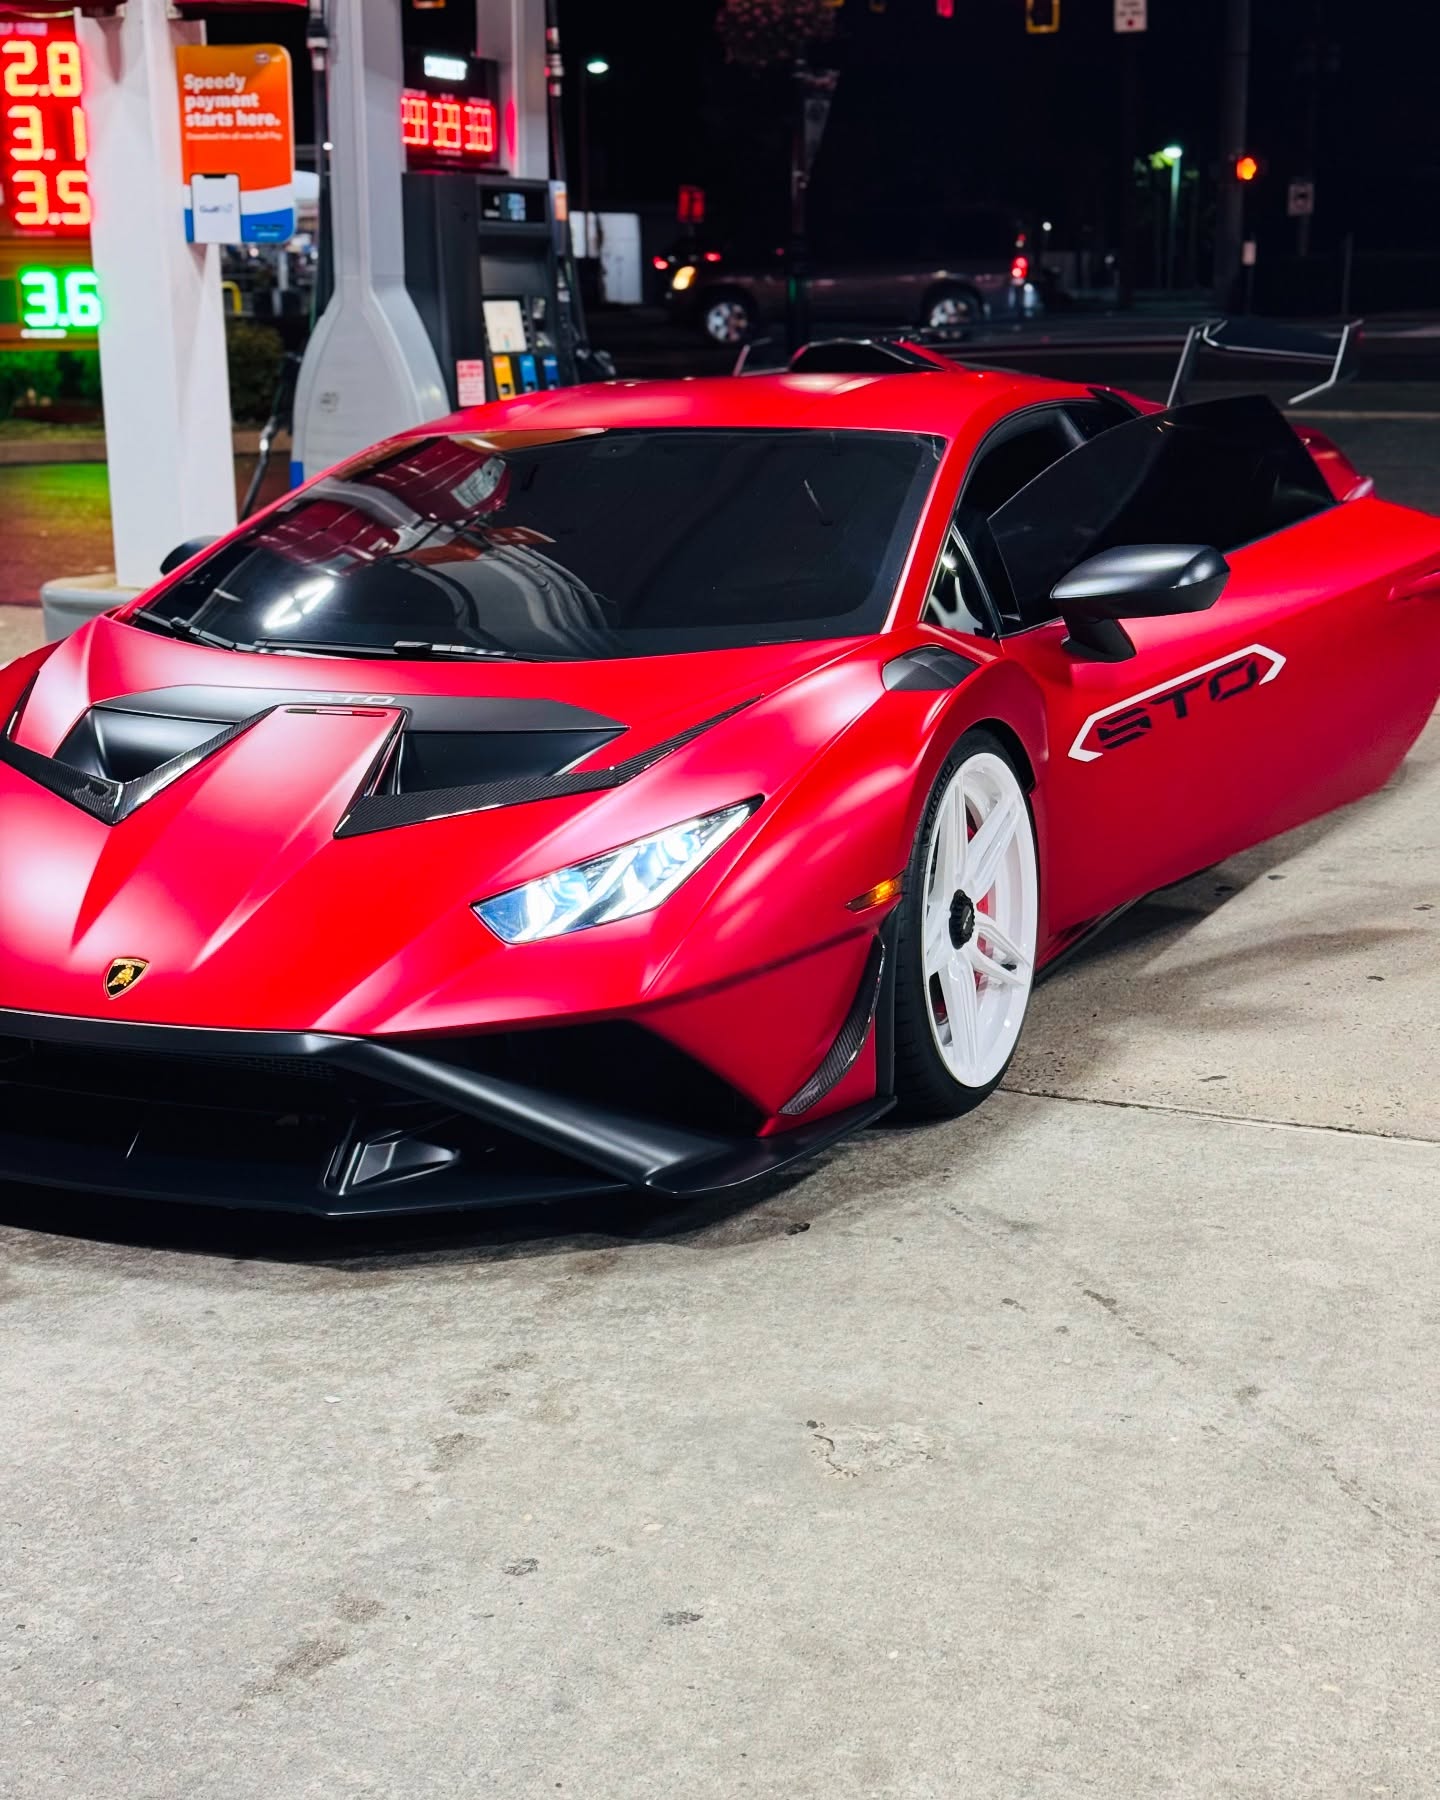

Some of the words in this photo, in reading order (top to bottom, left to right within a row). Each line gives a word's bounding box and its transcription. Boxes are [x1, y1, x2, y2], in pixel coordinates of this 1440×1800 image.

[184, 72, 246, 94] Speedy
[184, 92, 260, 113] payment
[185, 112, 234, 127] starts
[236, 109, 281, 127] here.
[303, 693, 396, 705] STO
[1097, 658, 1259, 749] STO
